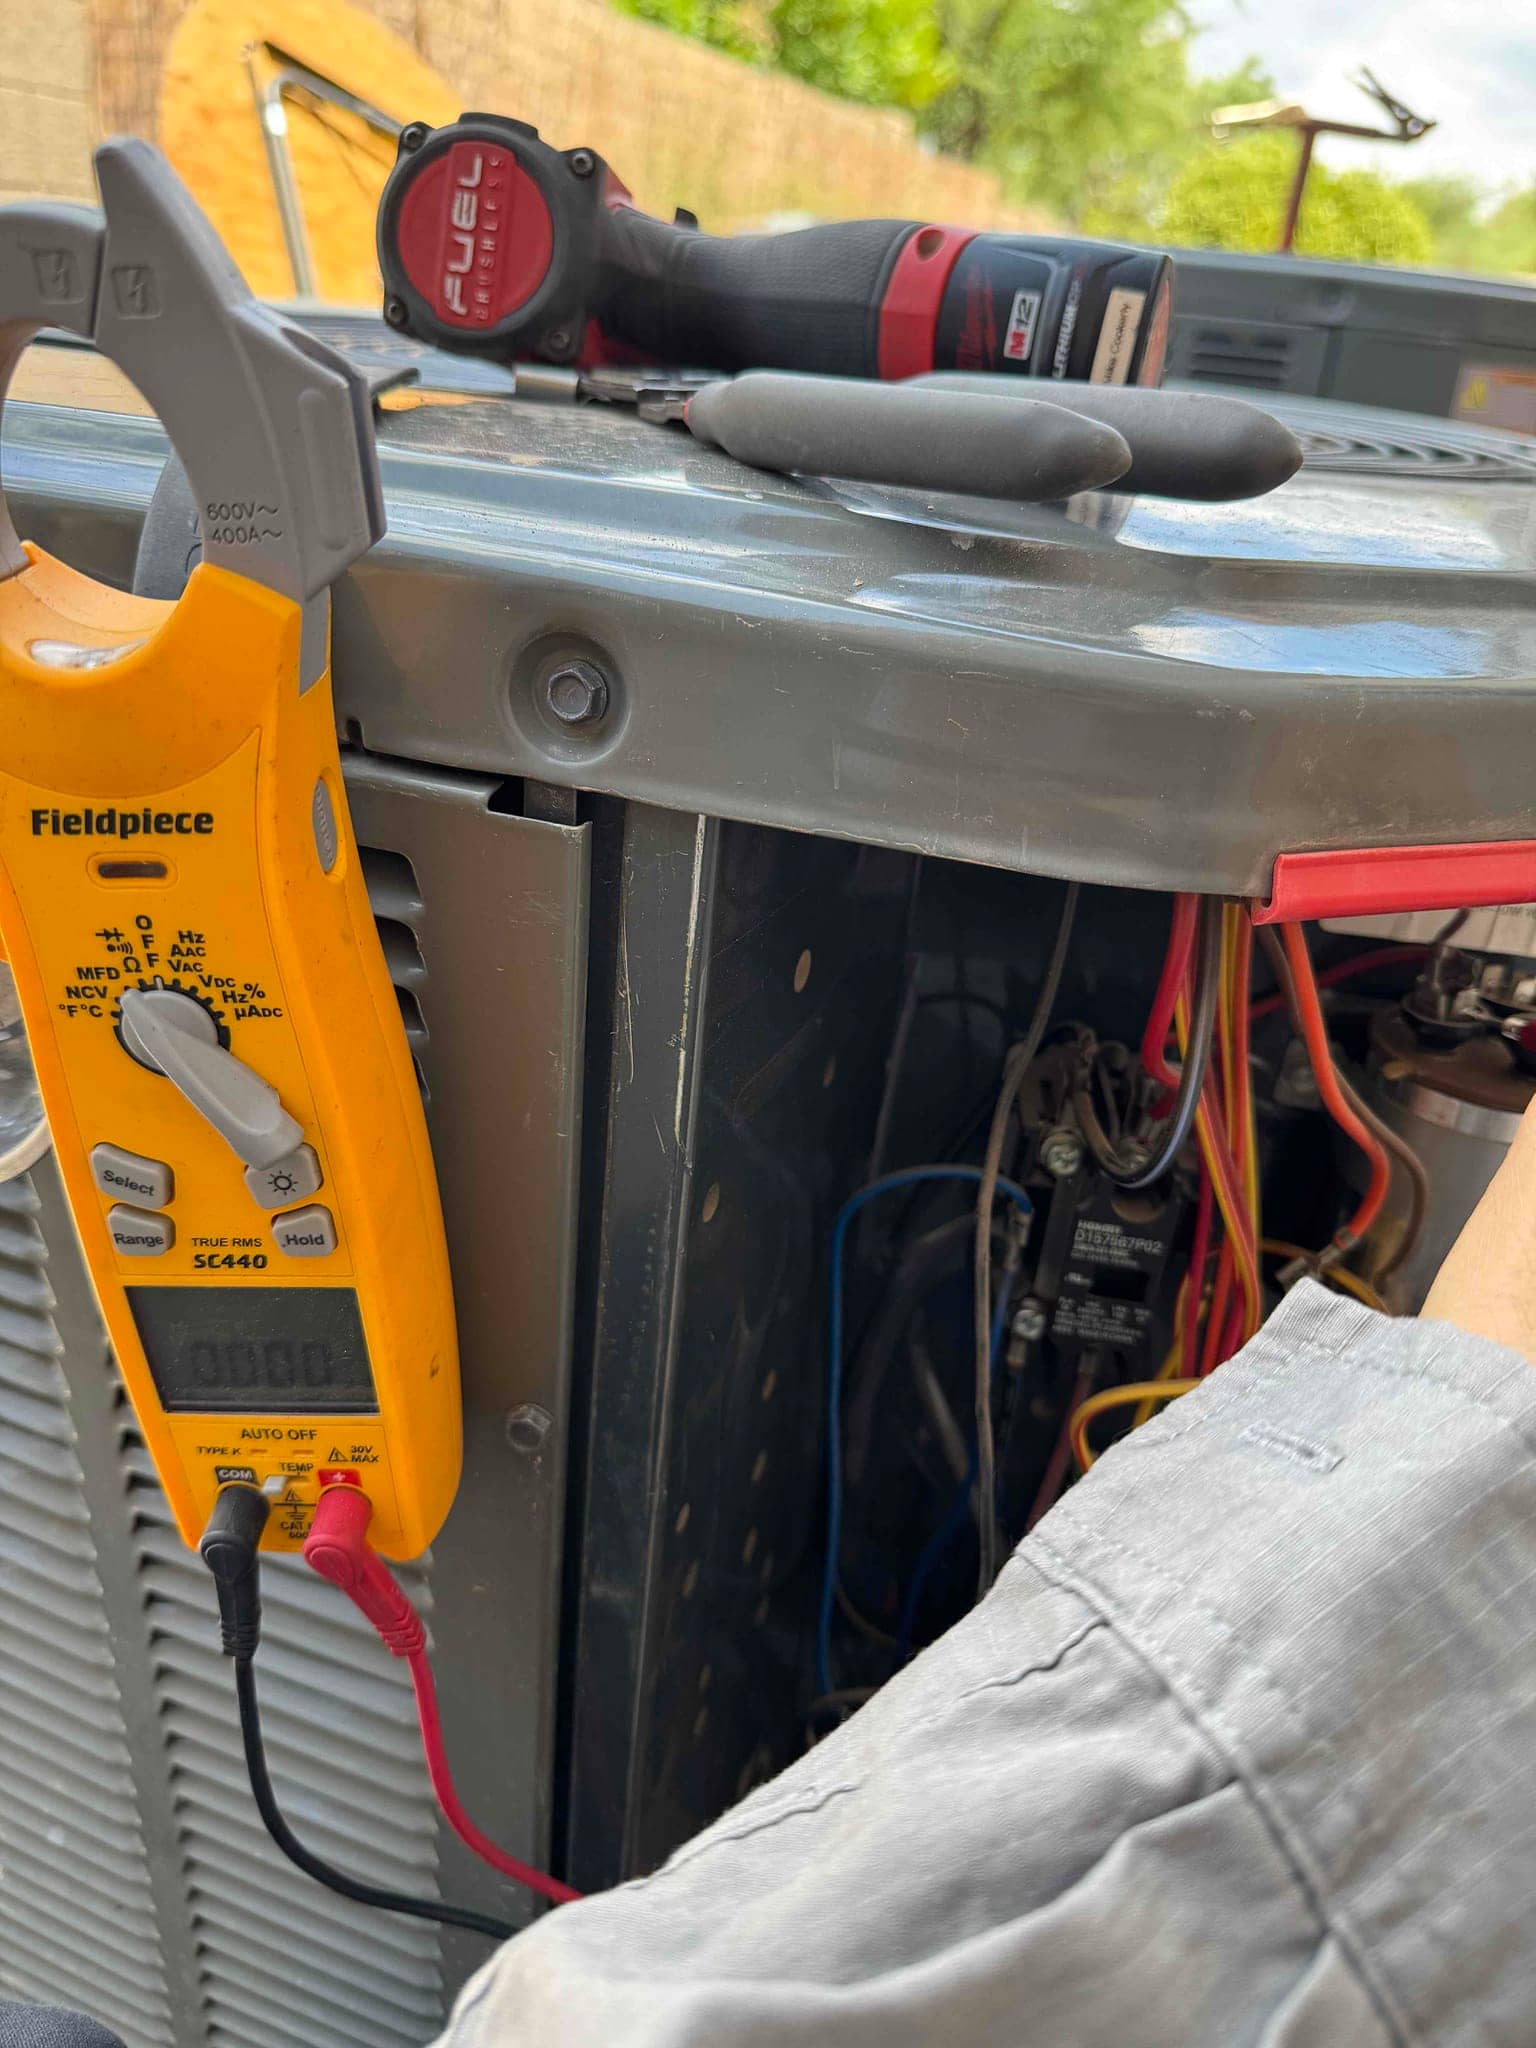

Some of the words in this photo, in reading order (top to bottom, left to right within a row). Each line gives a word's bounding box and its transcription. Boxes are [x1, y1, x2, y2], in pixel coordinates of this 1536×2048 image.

[444, 153, 484, 316] FUEL
[1009, 297, 1033, 356] M12
[31, 808, 214, 839] Fieldpiece
[178, 930, 205, 944] Hz
[76, 967, 120, 980] MFD
[65, 985, 108, 999] NCV
[103, 1169, 155, 1197] Select
[114, 1233, 164, 1247] Range
[192, 1237, 228, 1247] TRUE
[232, 1237, 262, 1247] RMS
[285, 1234, 325, 1246] Hold
[194, 1254, 267, 1269] SC440
[241, 1428, 283, 1440] AUTO
[287, 1429, 317, 1440] OFF
[197, 1447, 228, 1455] TYPE
[232, 1447, 241, 1455] K
[351, 1445, 373, 1454] 30V
[351, 1455, 379, 1463] MAX
[279, 1463, 314, 1472] TEMP
[218, 1470, 253, 1479] COM
[280, 1521, 303, 1530] CAT
